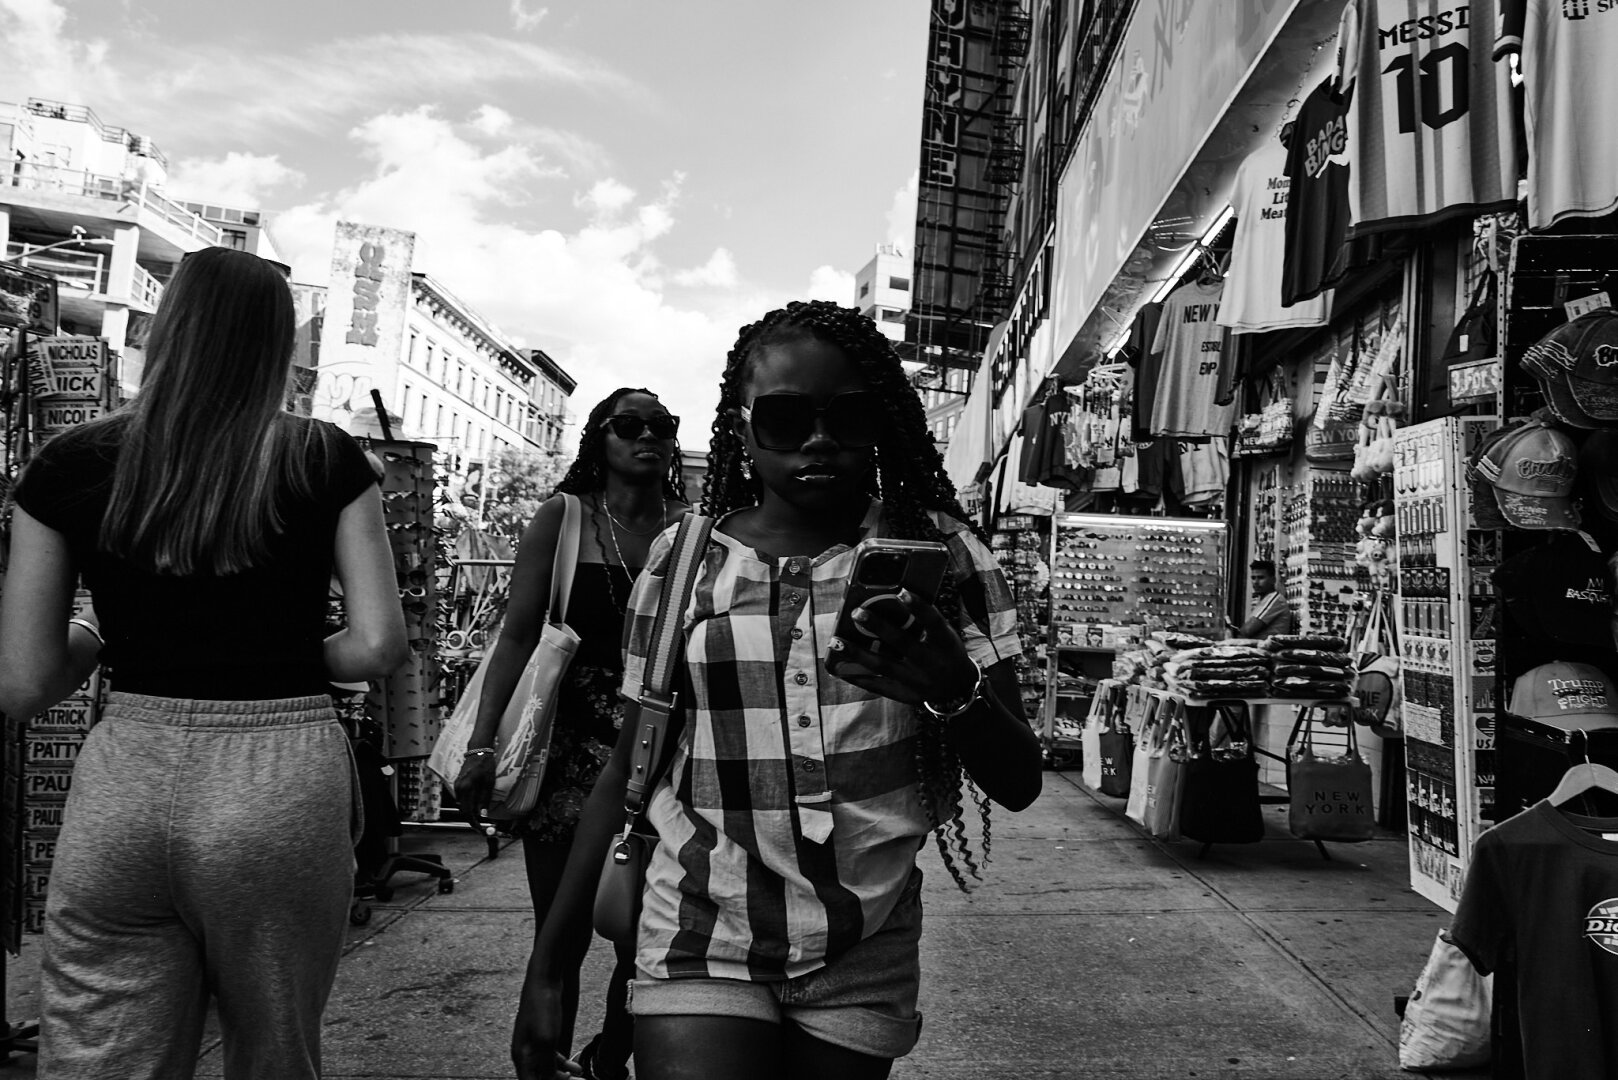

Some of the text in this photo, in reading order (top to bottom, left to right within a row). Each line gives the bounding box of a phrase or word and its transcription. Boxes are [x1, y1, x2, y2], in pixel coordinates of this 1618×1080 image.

[1379, 6, 1469, 50] MESSI
[1381, 42, 1469, 134] 10
[1306, 115, 1344, 156] BADA
[1183, 304, 1209, 323] NEW
[47, 344, 99, 361] NICHOLAS
[1305, 430, 1333, 446] NEW
[1547, 678, 1604, 692] Trump
[34, 708, 87, 725] PATRICK
[33, 742, 83, 759] PATTY
[1315, 791, 1360, 801] NEW
[1306, 804, 1365, 815] YORK
